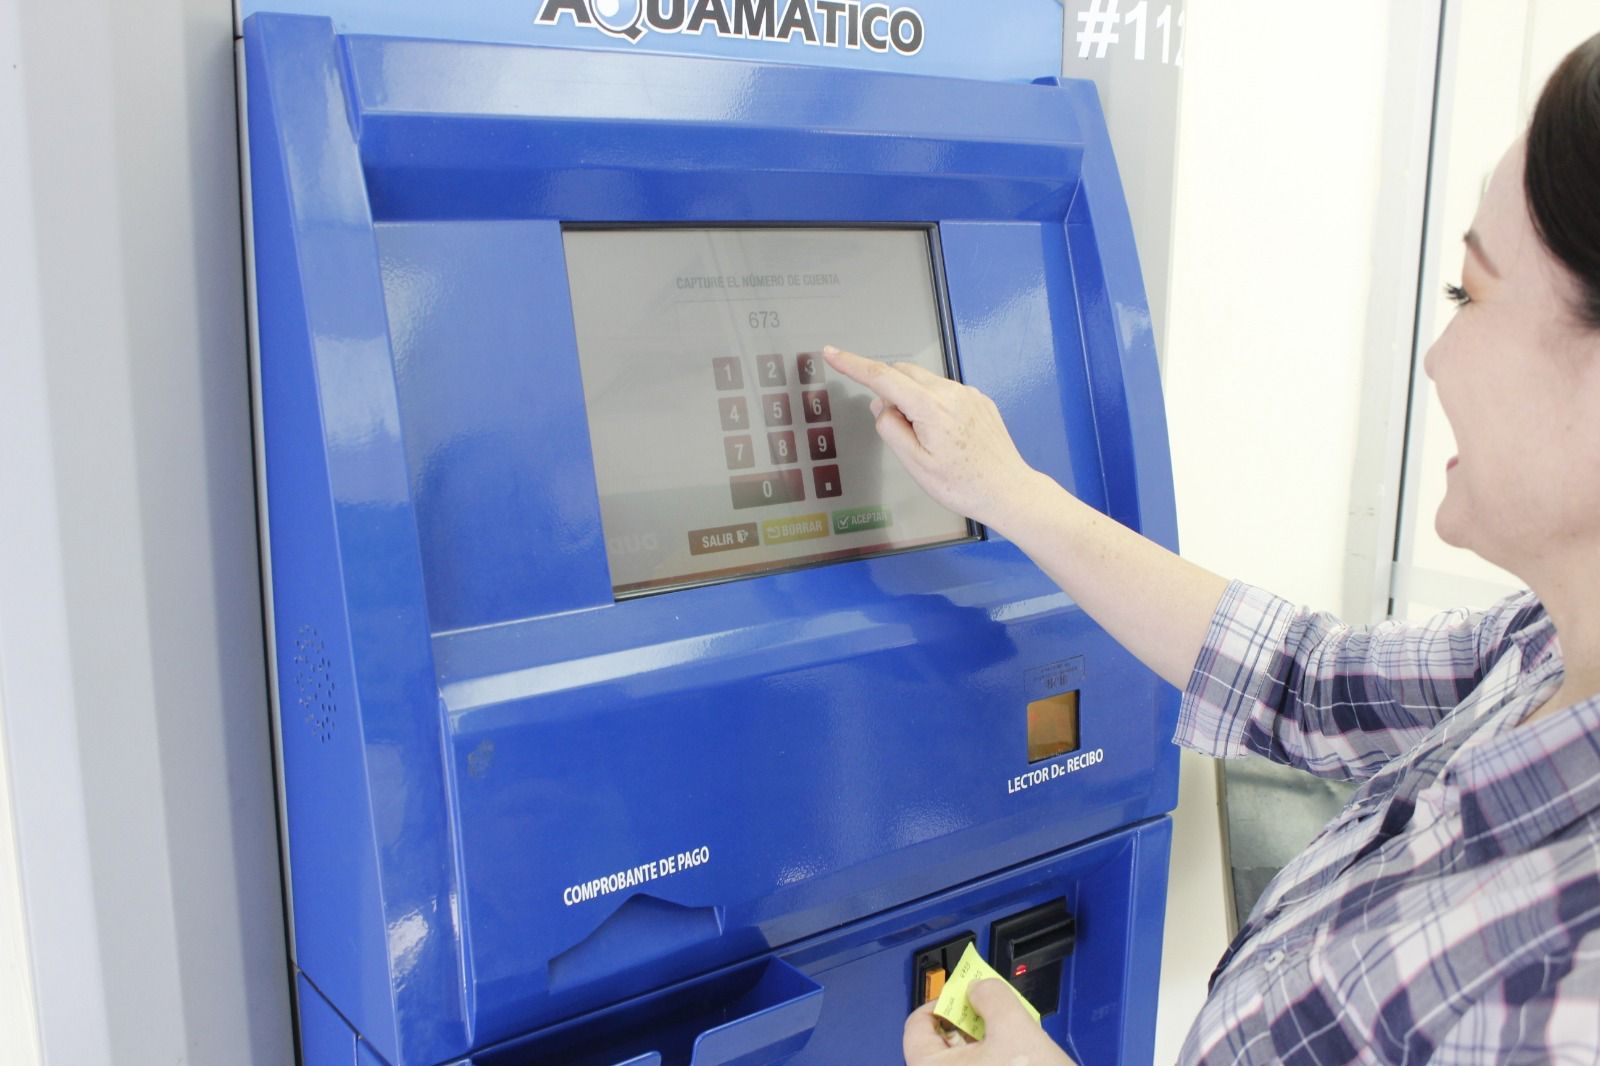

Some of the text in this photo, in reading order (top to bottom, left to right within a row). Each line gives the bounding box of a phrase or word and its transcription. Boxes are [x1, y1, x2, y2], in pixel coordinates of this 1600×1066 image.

[676, 275, 725, 289] CAPTURE
[727, 275, 740, 288] EL
[787, 274, 800, 286] DE
[802, 273, 840, 286] CUENTA
[749, 311, 780, 328] 673
[723, 359, 816, 382] 1 2 3
[730, 398, 822, 423] 4 5 6
[734, 435, 827, 461] 7 8 9
[762, 480, 772, 497] 0
[702, 511, 888, 549] SALIR BORRAR ACEPTAR
[1008, 767, 1049, 794] LECTOR
[1067, 748, 1104, 774] RECIBO
[563, 845, 710, 906] COMPROBANTE DE PAGO
